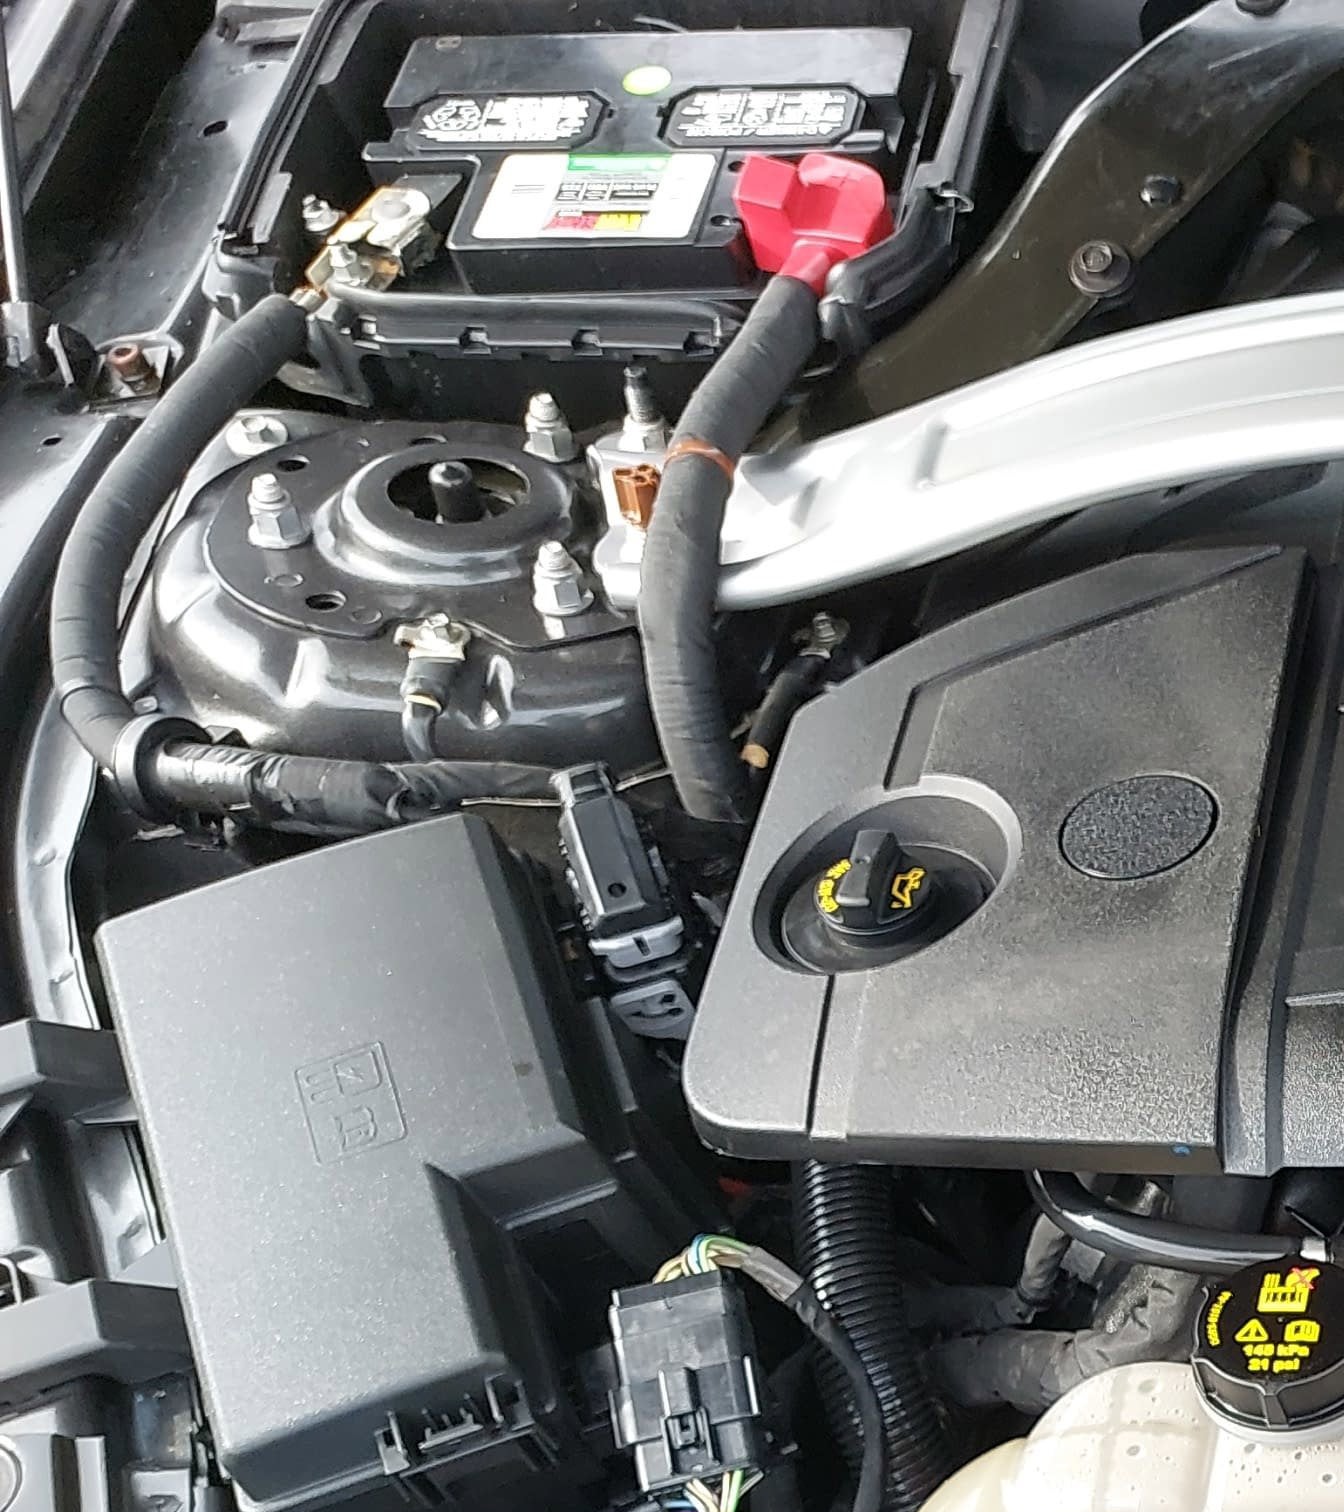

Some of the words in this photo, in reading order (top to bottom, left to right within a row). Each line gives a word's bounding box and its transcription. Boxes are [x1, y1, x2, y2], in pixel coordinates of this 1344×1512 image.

[1276, 1343, 1311, 1357] kPa
[1247, 1358, 1270, 1372] 21
[1272, 1358, 1301, 1374] psi
